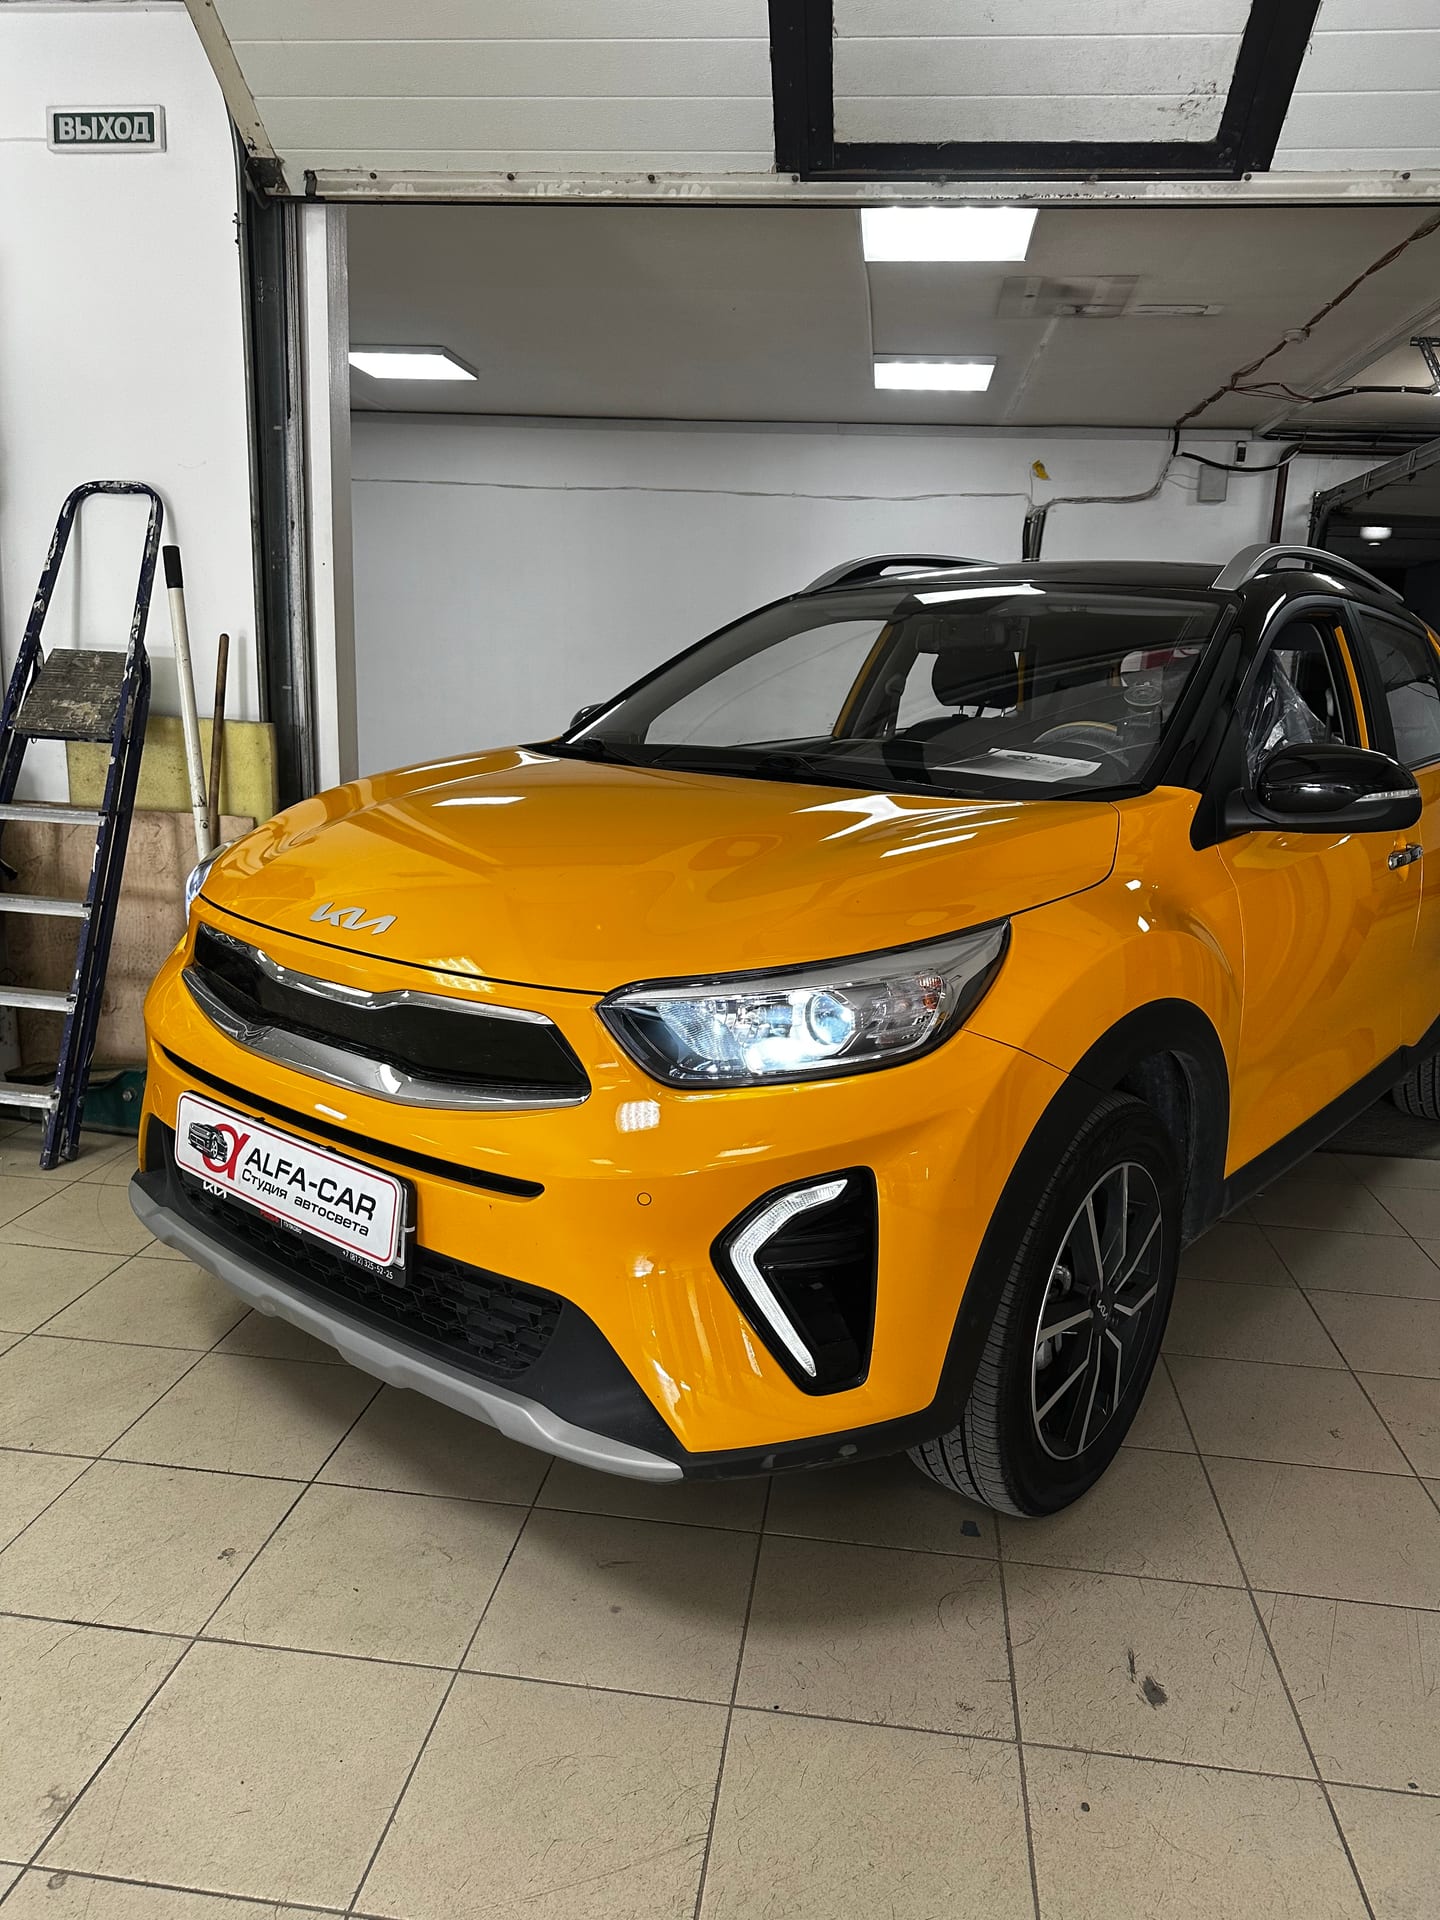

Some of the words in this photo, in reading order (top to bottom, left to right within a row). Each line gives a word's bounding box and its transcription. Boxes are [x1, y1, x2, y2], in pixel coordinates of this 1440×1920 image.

[58, 116, 151, 141] ВЫХОД
[310, 902, 397, 935] KIA
[245, 1147, 376, 1221] ALFA-CAR
[242, 1168, 288, 1199] Студия
[294, 1196, 369, 1237] автосвета
[364, 1259, 393, 1279] 325-52-25
